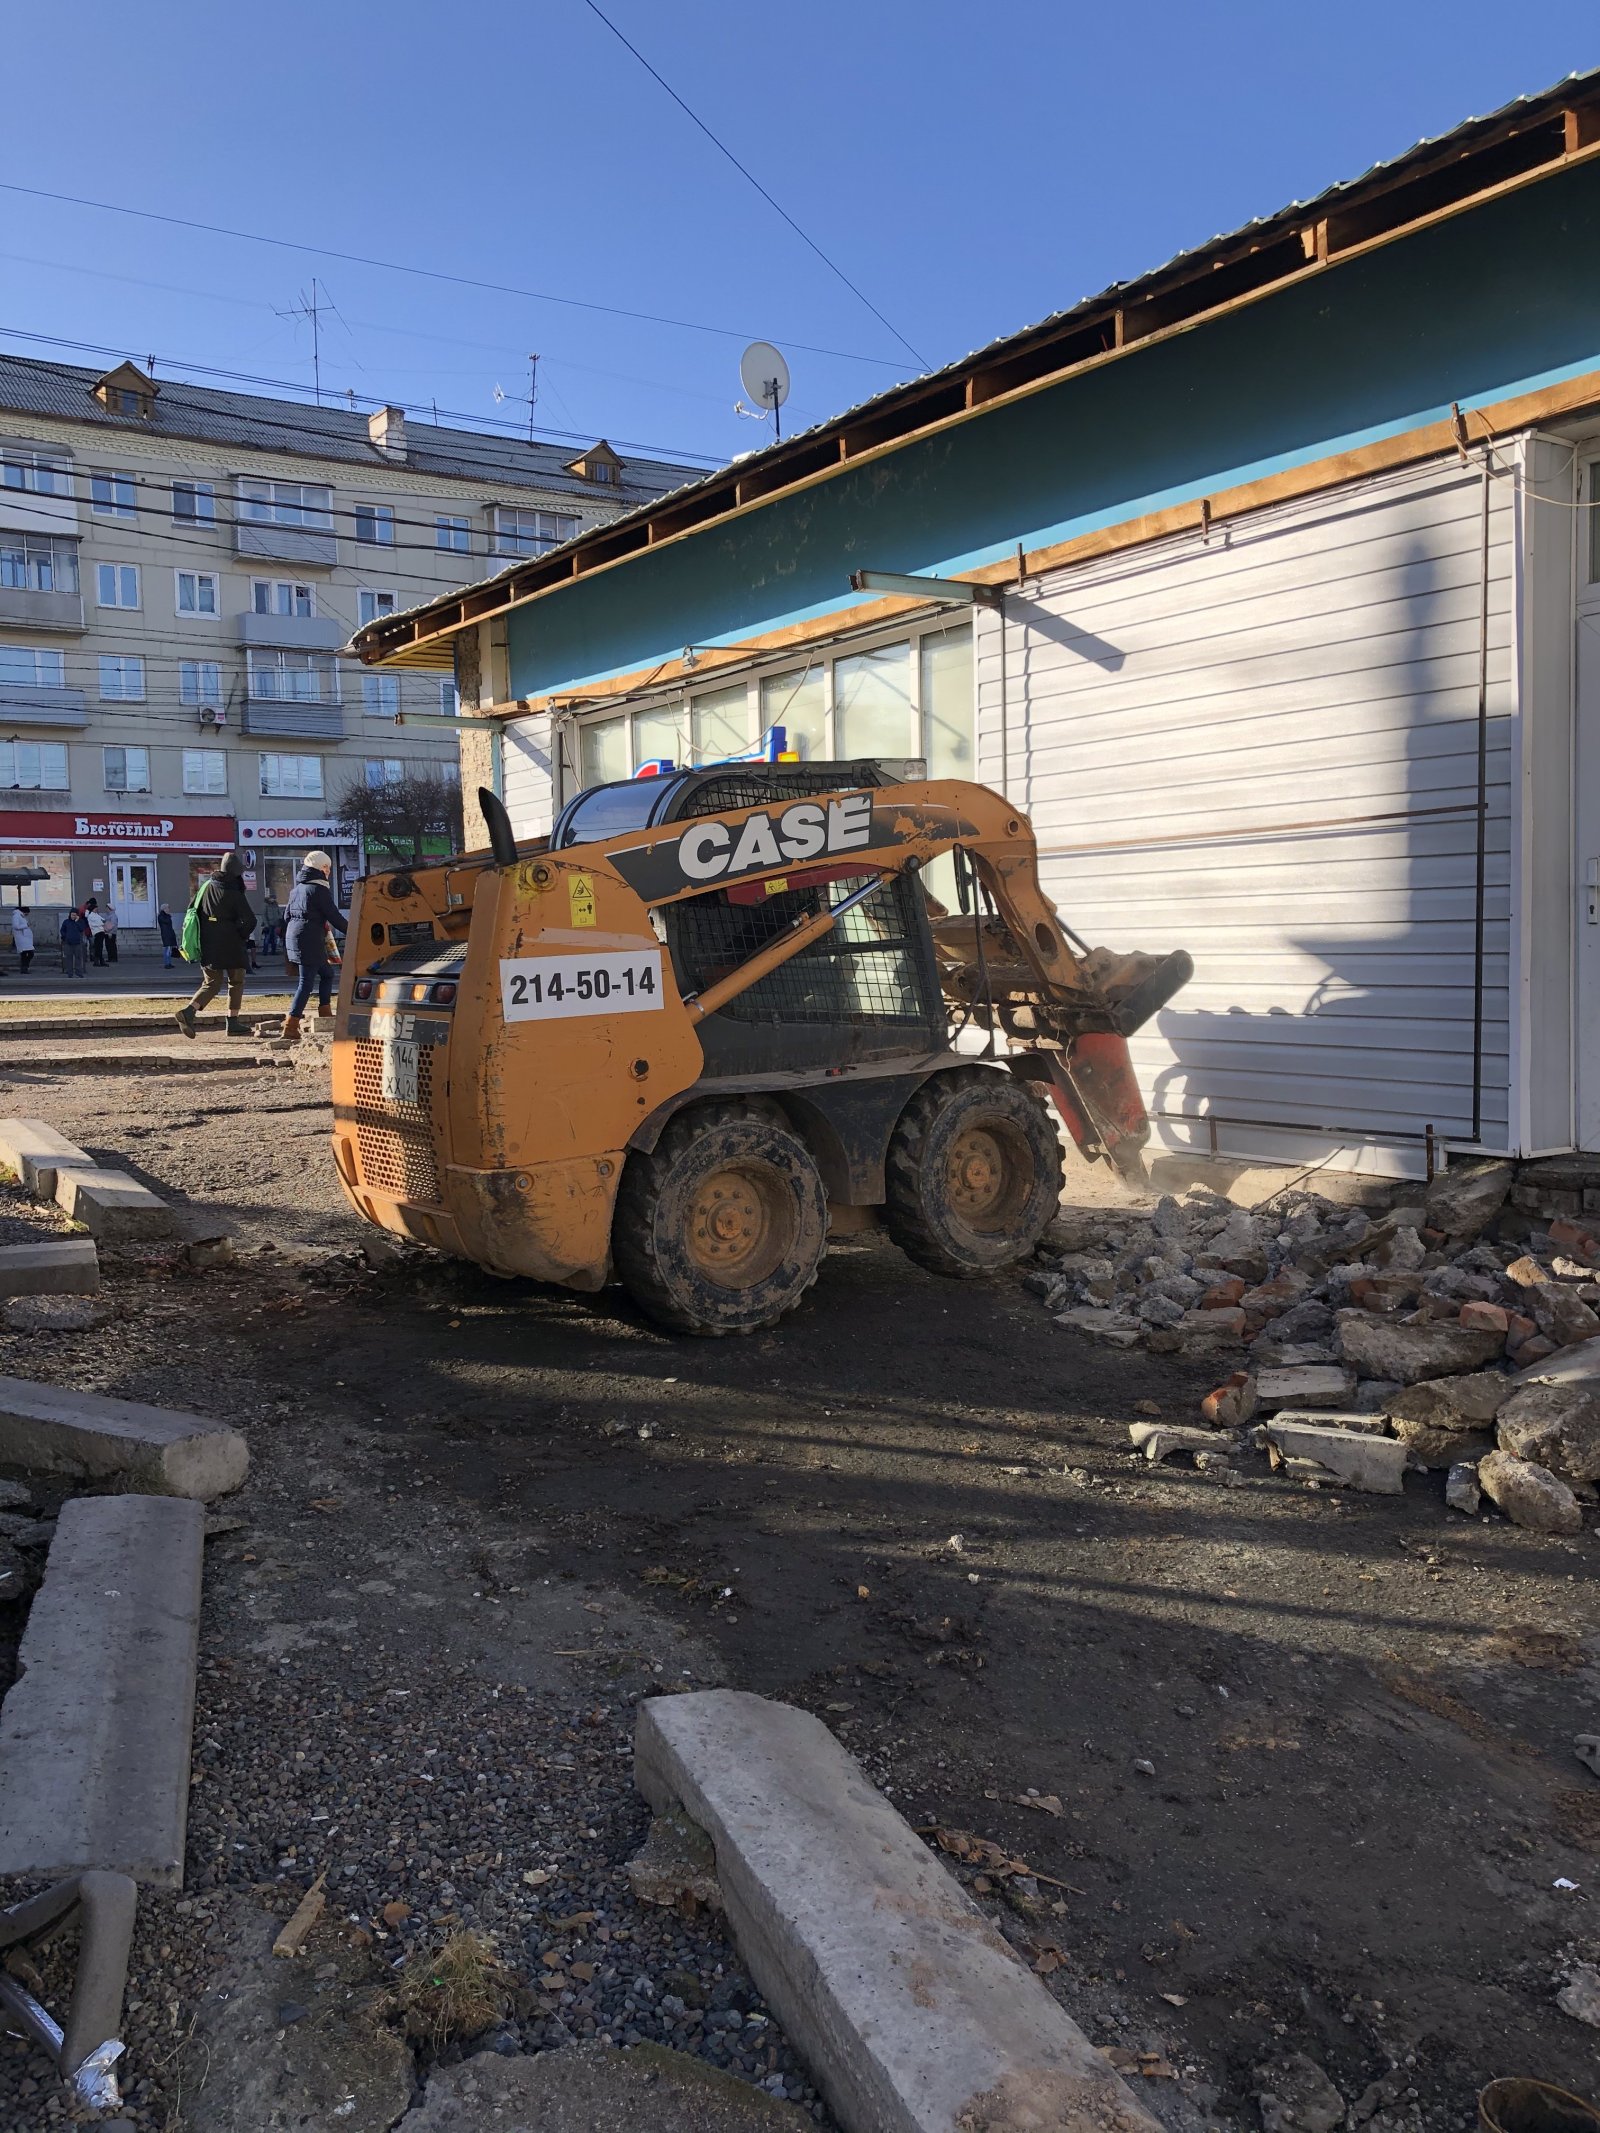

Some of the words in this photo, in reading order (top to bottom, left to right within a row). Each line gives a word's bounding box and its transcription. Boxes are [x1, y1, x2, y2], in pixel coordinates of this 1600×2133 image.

[257, 828, 354, 838] СОВКОМБАНК
[678, 796, 871, 880] CASE
[510, 966, 655, 1005] 214-50-14
[369, 1011, 416, 1039] CASE
